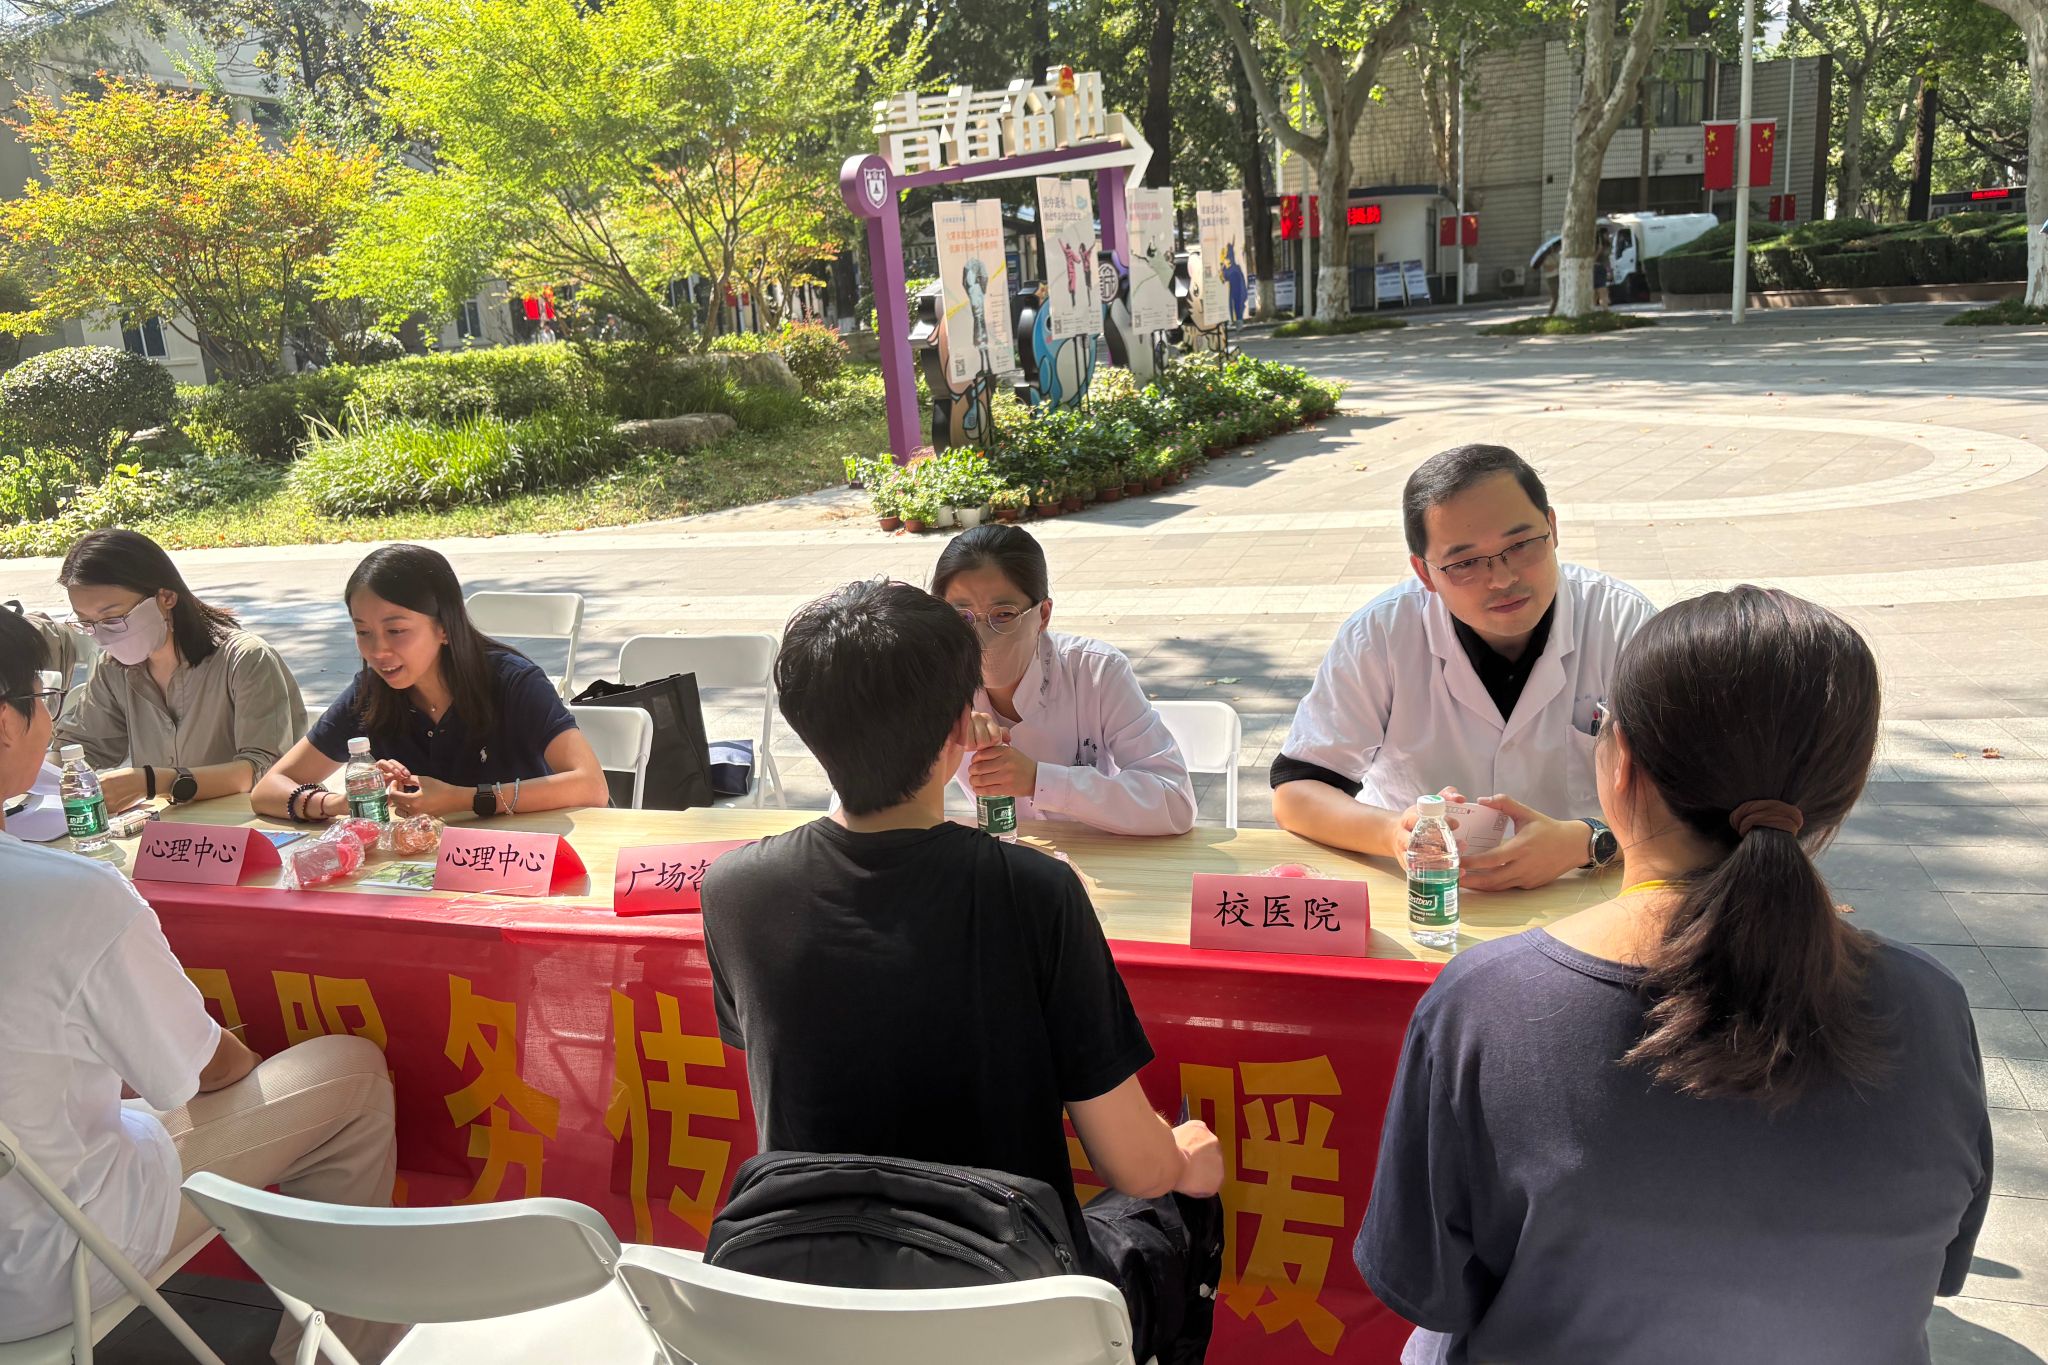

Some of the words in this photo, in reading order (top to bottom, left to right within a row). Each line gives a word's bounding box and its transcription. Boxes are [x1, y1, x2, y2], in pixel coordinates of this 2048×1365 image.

[145, 836, 237, 869] 心理中心
[445, 843, 545, 877] 心理中心
[1213, 890, 1341, 932] 校医院
